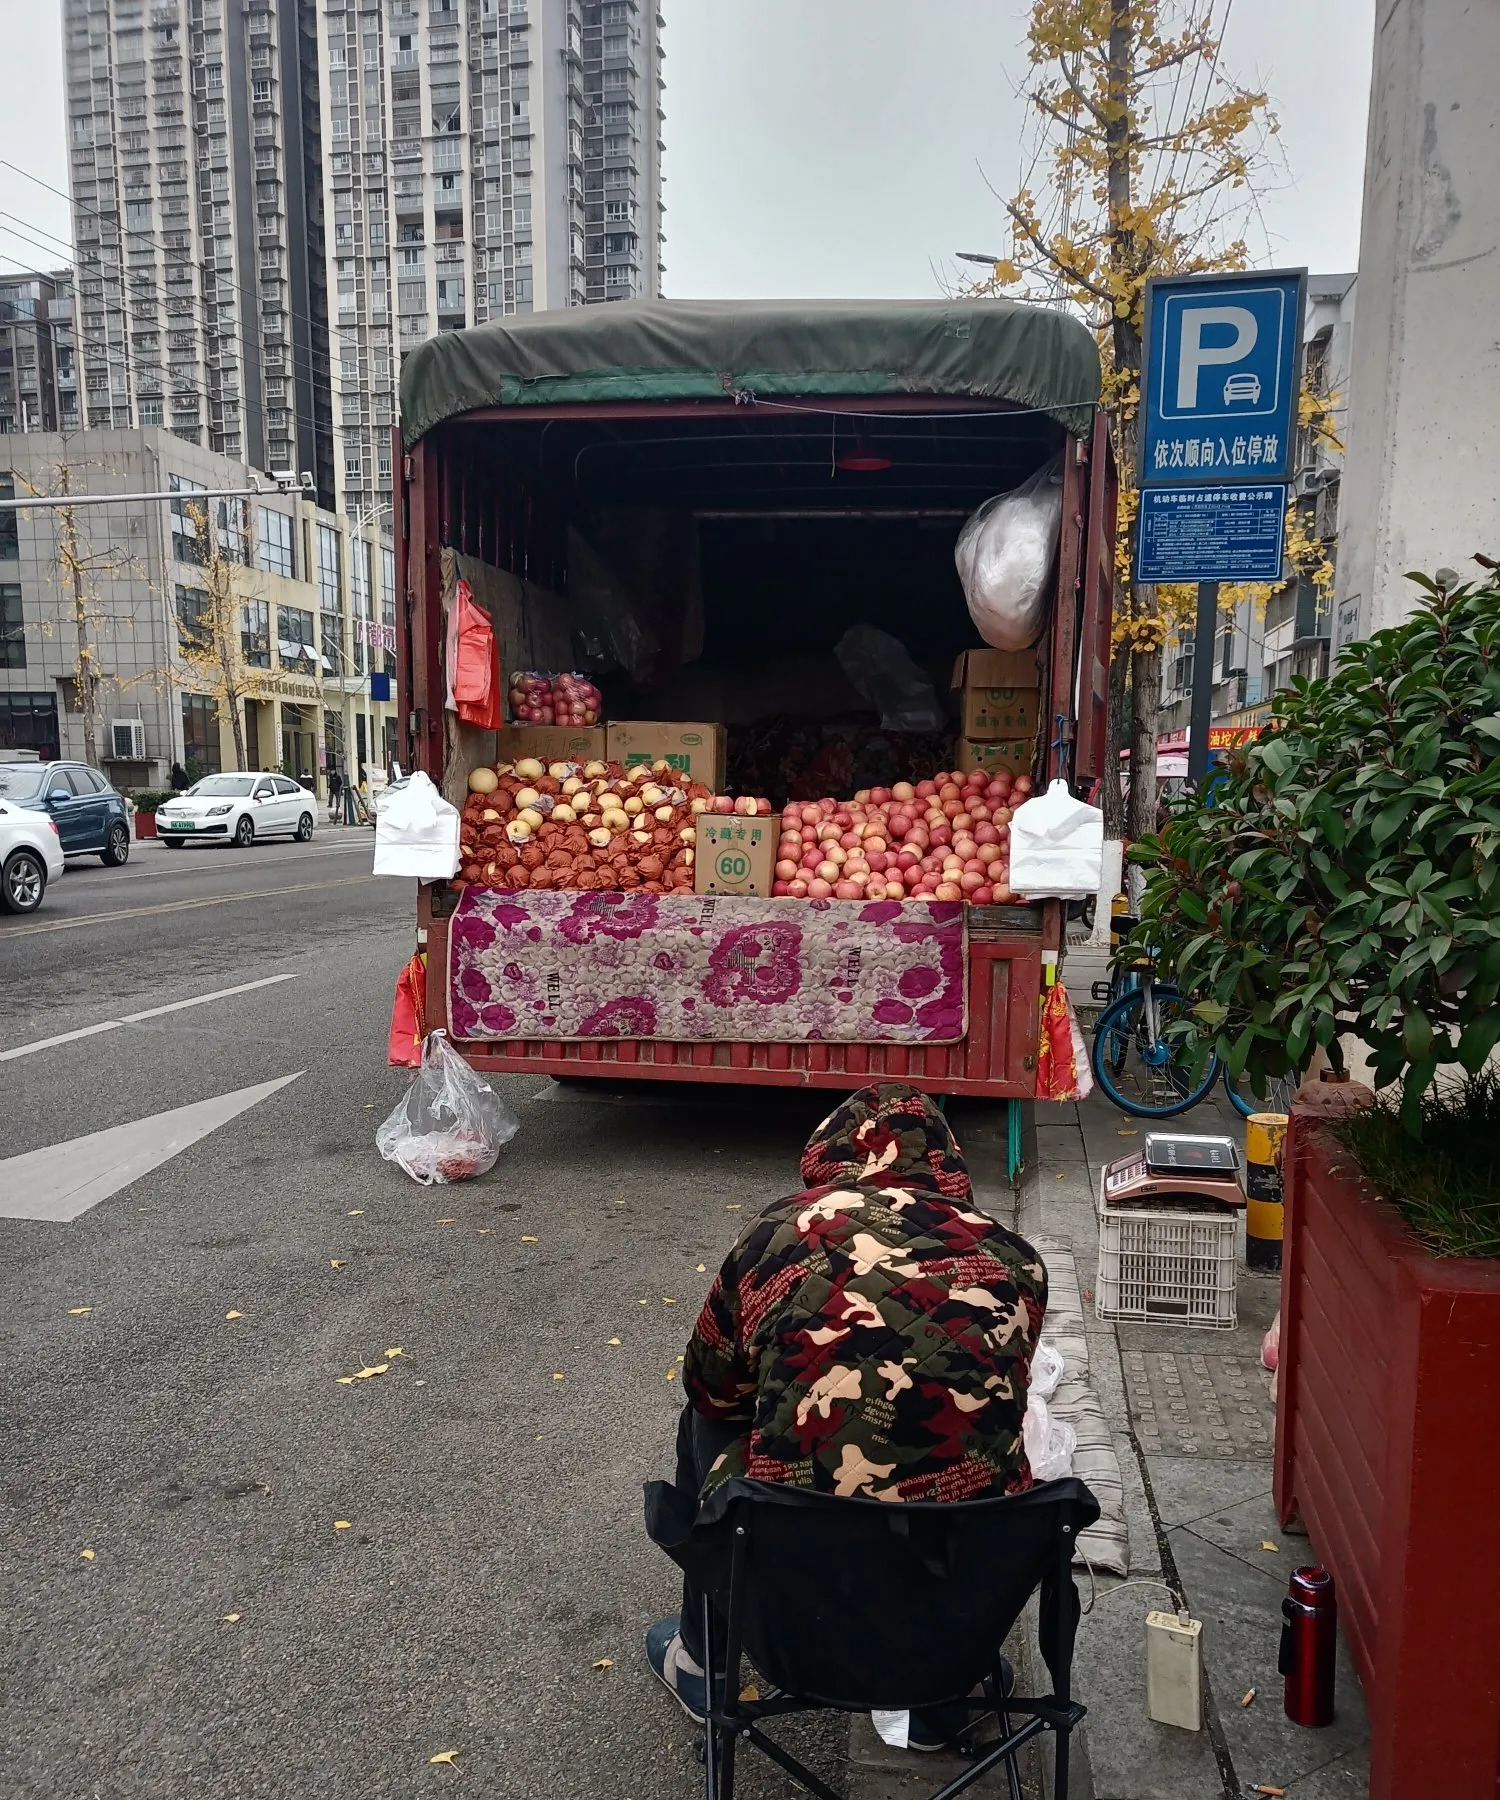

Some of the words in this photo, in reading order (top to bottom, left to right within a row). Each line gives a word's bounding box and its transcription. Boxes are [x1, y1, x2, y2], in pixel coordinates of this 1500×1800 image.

[1176, 305, 1258, 409] P
[1153, 434, 1279, 470] 依次顺向入位停放
[1153, 491, 1274, 504] 机动车临时占道停车收费公示牌
[705, 827, 762, 841] 冷藏专用
[720, 857, 746, 876] 60
[699, 898, 717, 926] WELL
[846, 945, 862, 987] WELL
[546, 971, 560, 1011] WELL
